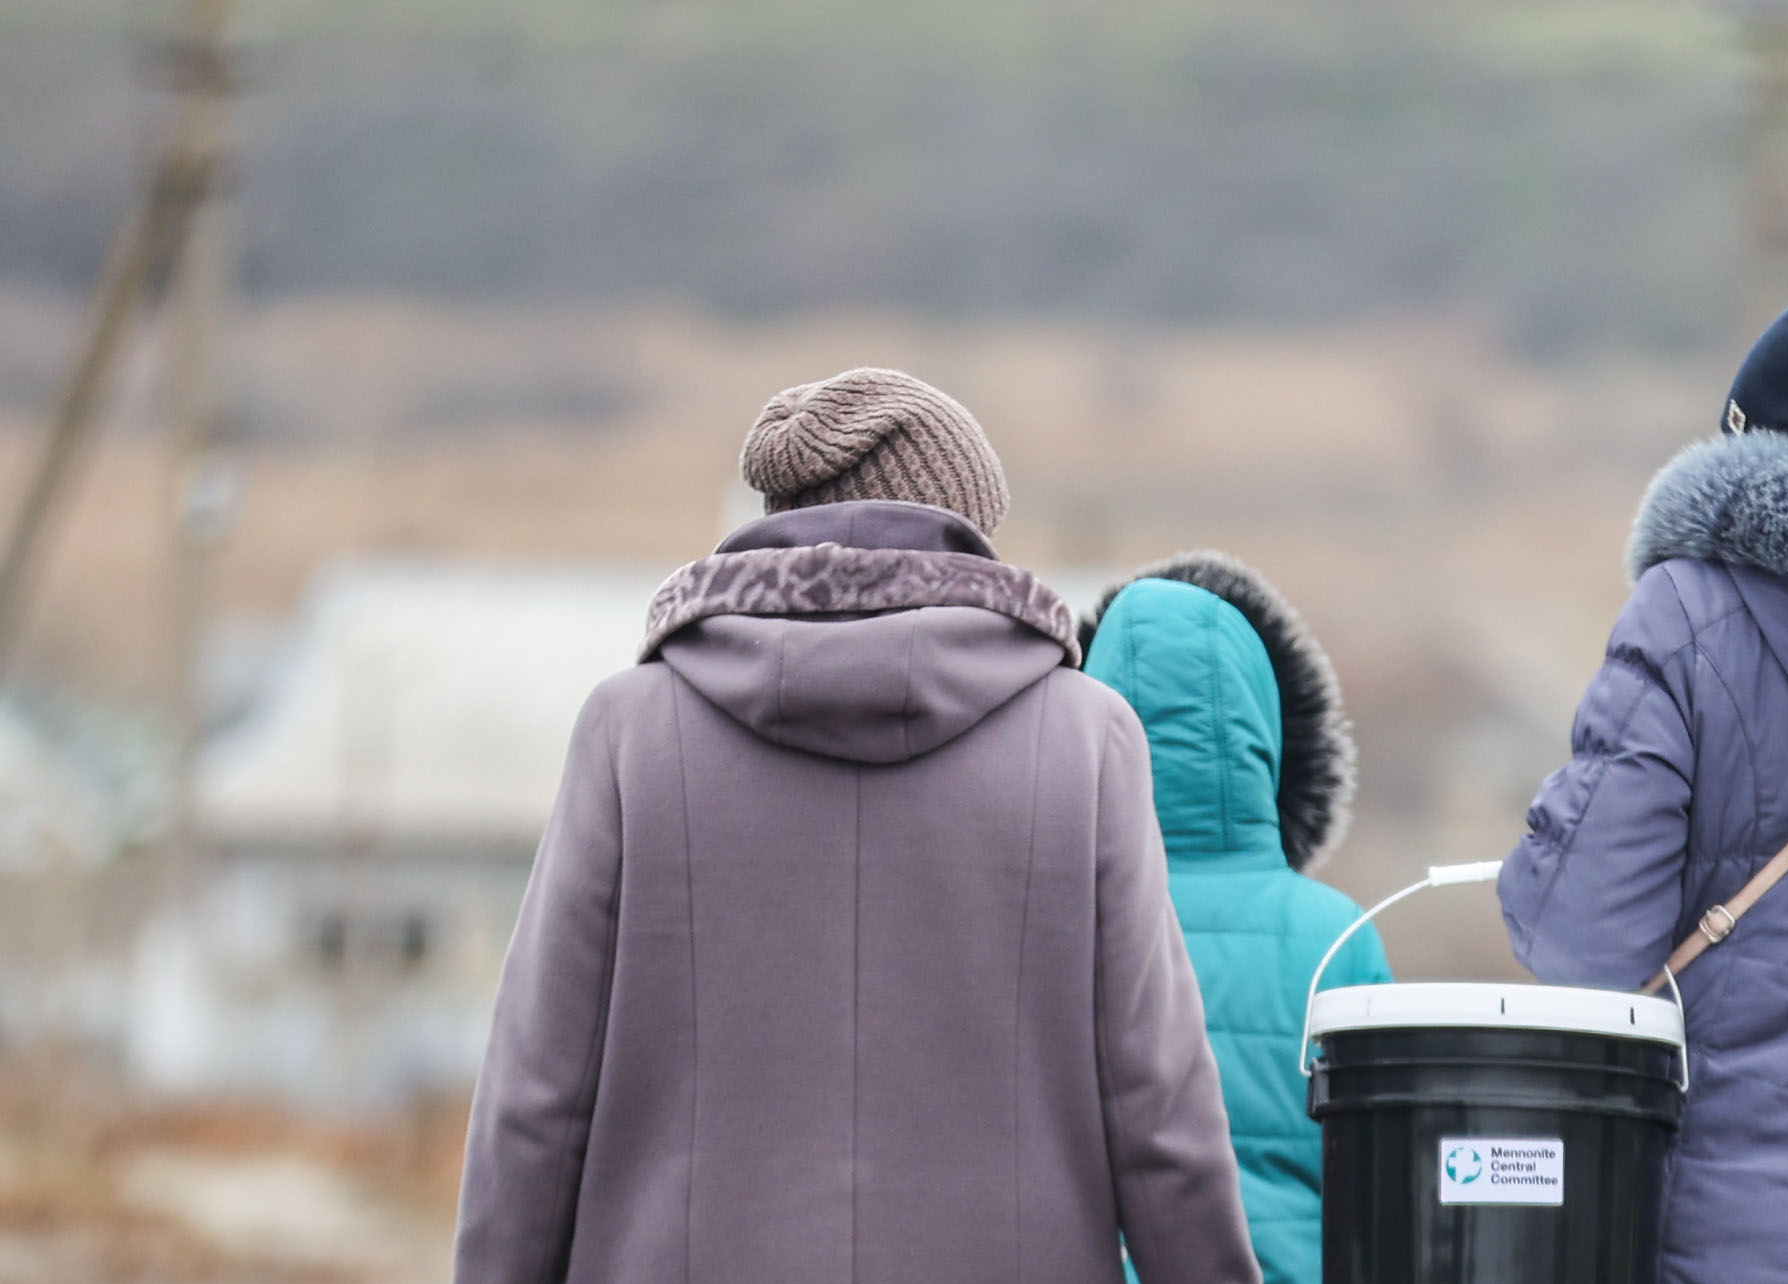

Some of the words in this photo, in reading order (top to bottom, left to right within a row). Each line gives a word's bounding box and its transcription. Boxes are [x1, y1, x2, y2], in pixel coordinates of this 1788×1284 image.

[1491, 1147, 1556, 1159] Mennonite
[1491, 1160, 1537, 1172] Central
[1491, 1173, 1559, 1185] Committee
